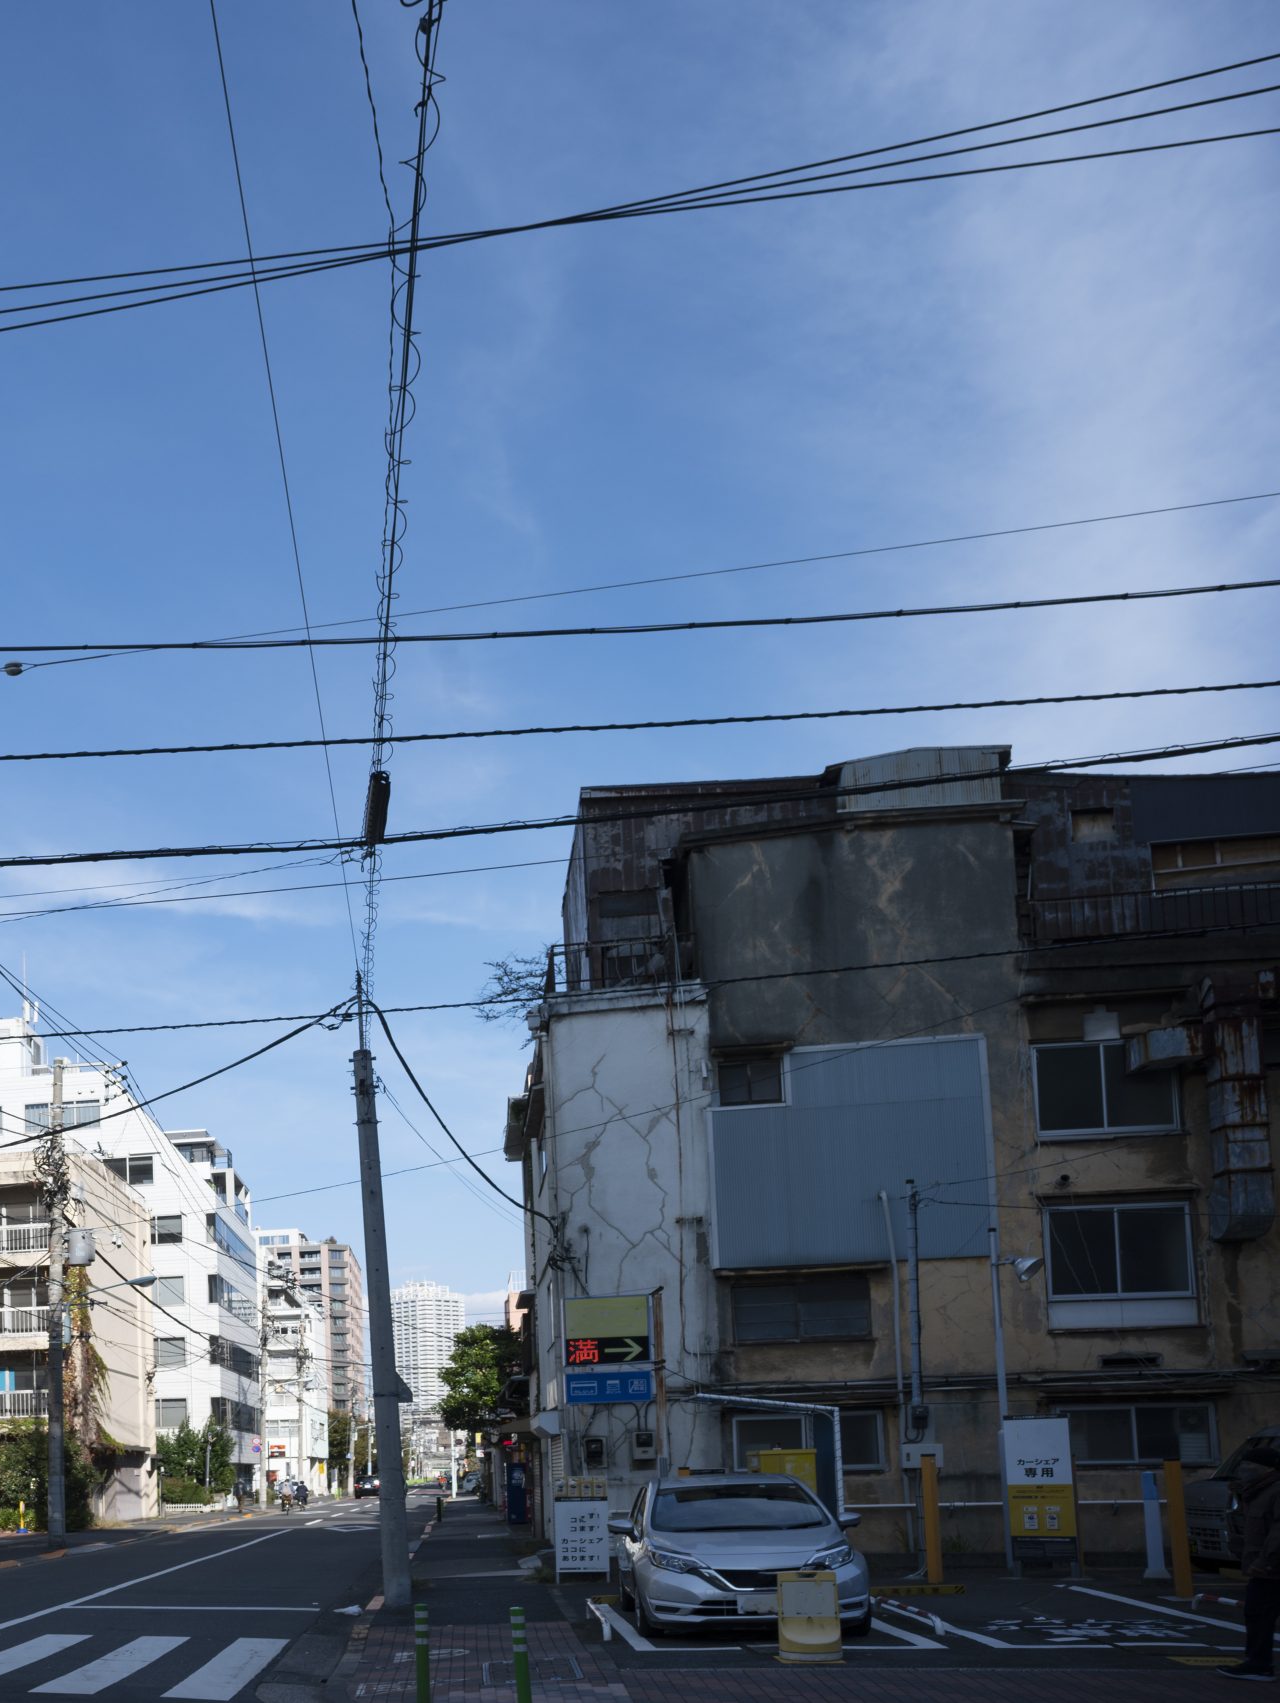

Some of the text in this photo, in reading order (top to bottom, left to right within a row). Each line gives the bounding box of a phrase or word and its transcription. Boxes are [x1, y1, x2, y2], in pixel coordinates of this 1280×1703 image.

[567, 1338, 600, 1364] 満
[1017, 1457, 1060, 1466] カーシェア
[1024, 1467, 1055, 1478] 専用
[561, 1537, 603, 1545] カーシェア
